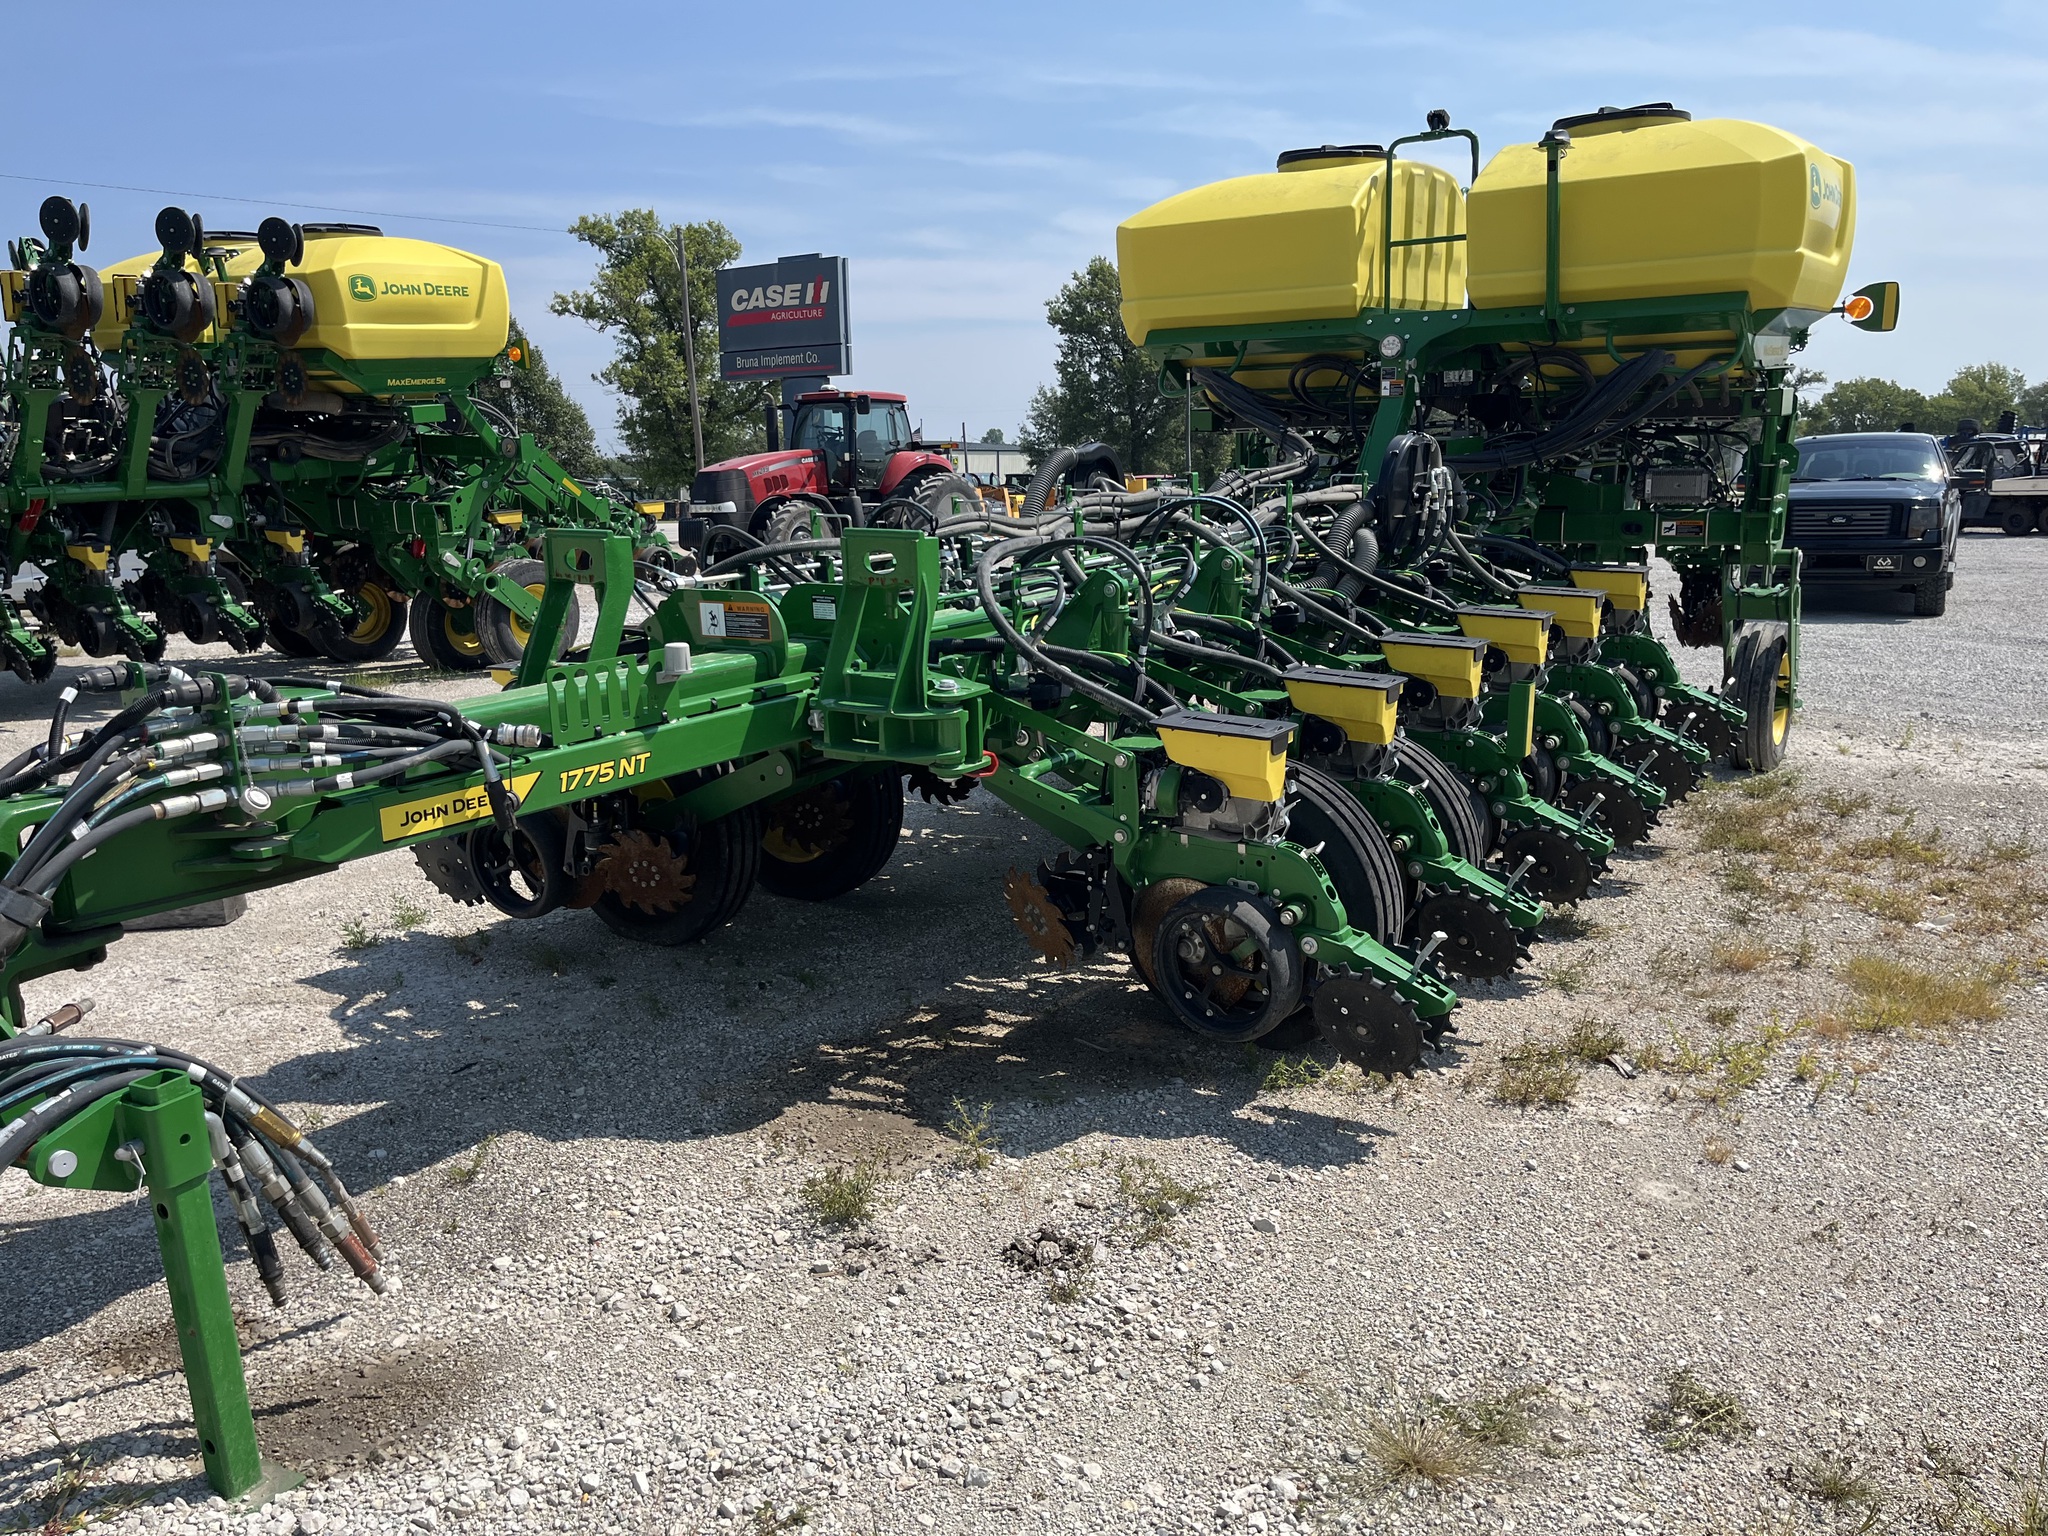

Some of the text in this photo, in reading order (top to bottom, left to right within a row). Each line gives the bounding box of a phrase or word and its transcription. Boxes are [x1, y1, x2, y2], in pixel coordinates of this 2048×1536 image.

[381, 281, 469, 297] JOHN DEERE
[731, 283, 802, 311] CASE
[771, 308, 823, 320] AGRICULTURE
[736, 351, 820, 368] Bruna Implement Co.
[736, 605, 765, 613] WARNING
[559, 751, 652, 793] 1775 NT
[400, 795, 488, 827] JOHN DEE
